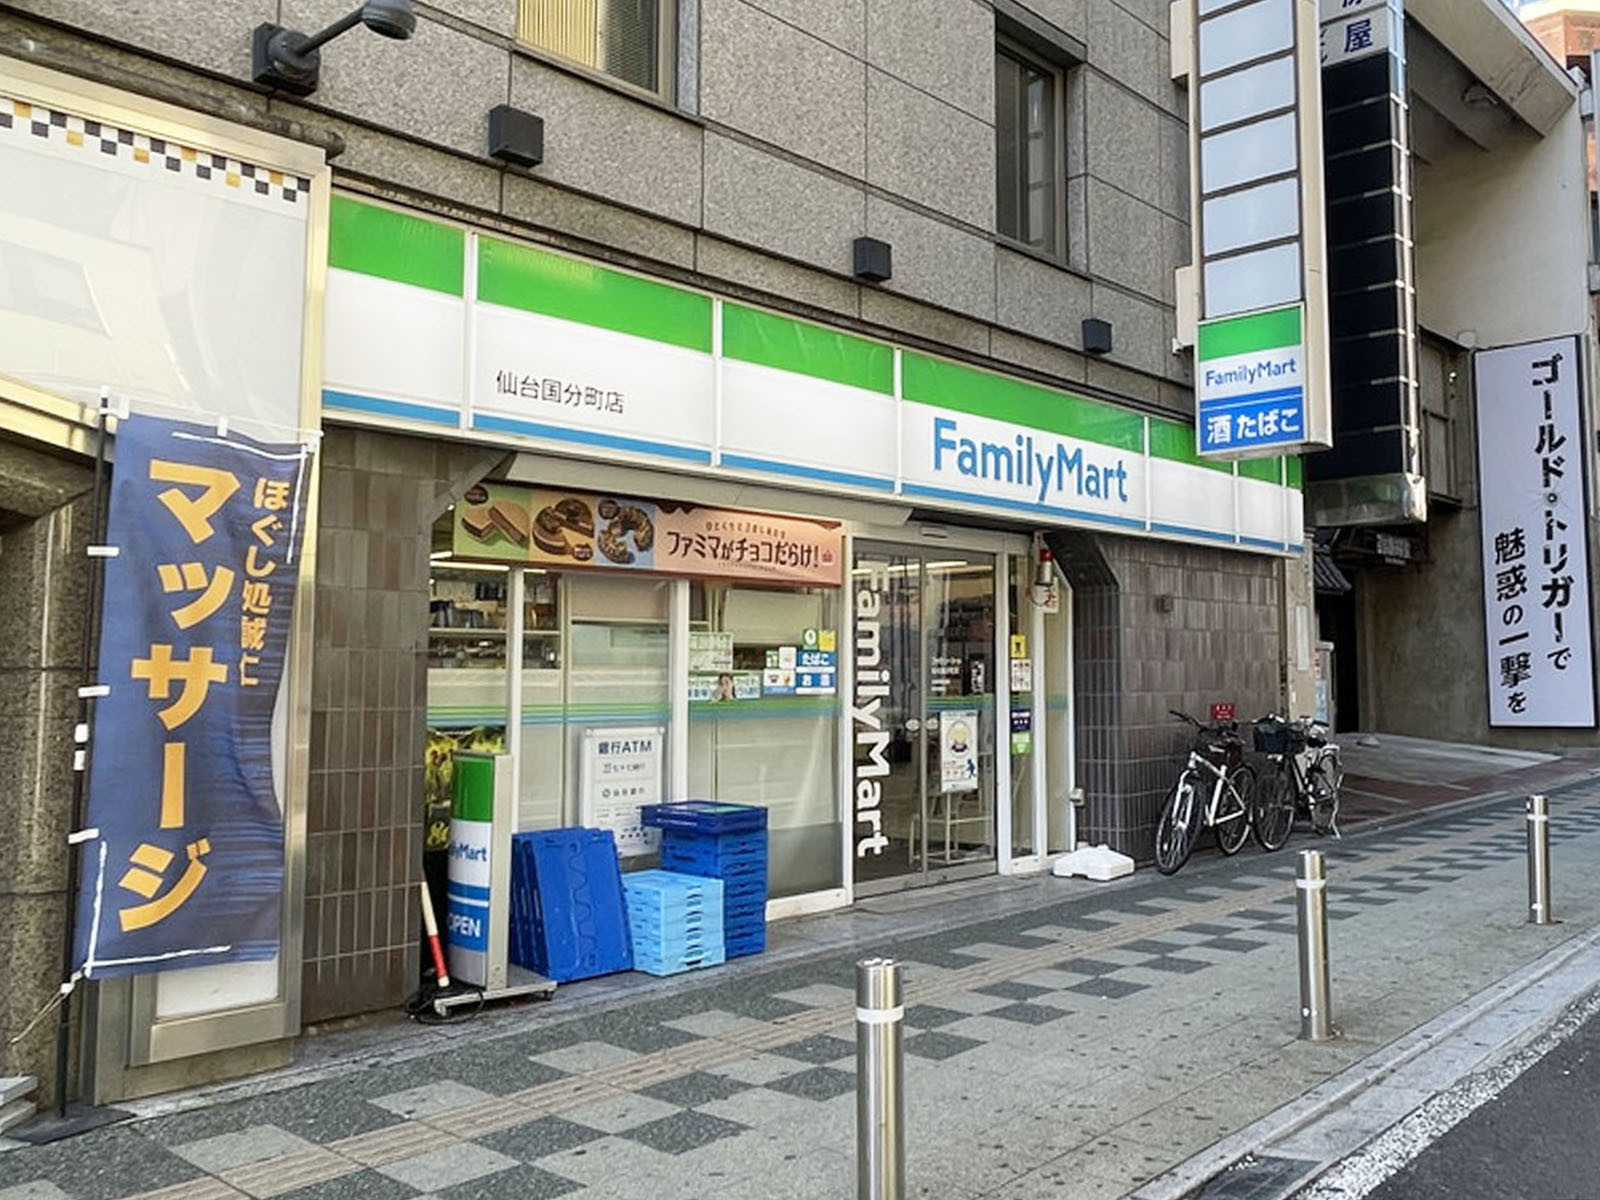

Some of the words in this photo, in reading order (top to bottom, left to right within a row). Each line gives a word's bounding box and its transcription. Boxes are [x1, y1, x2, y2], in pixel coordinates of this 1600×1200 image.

[496, 369, 625, 414] 仙台国分町店
[1205, 358, 1296, 387] FamilyMart
[1207, 414, 1232, 443] 酒
[1237, 408, 1299, 439] たばこ
[934, 416, 1128, 503] FamilyMart
[666, 531, 819, 568] ファミマがチョコだらけ!
[1494, 527, 1531, 714] 魅惑の一撃を
[119, 458, 241, 932] マッサージ
[852, 561, 891, 858] FamilyMart
